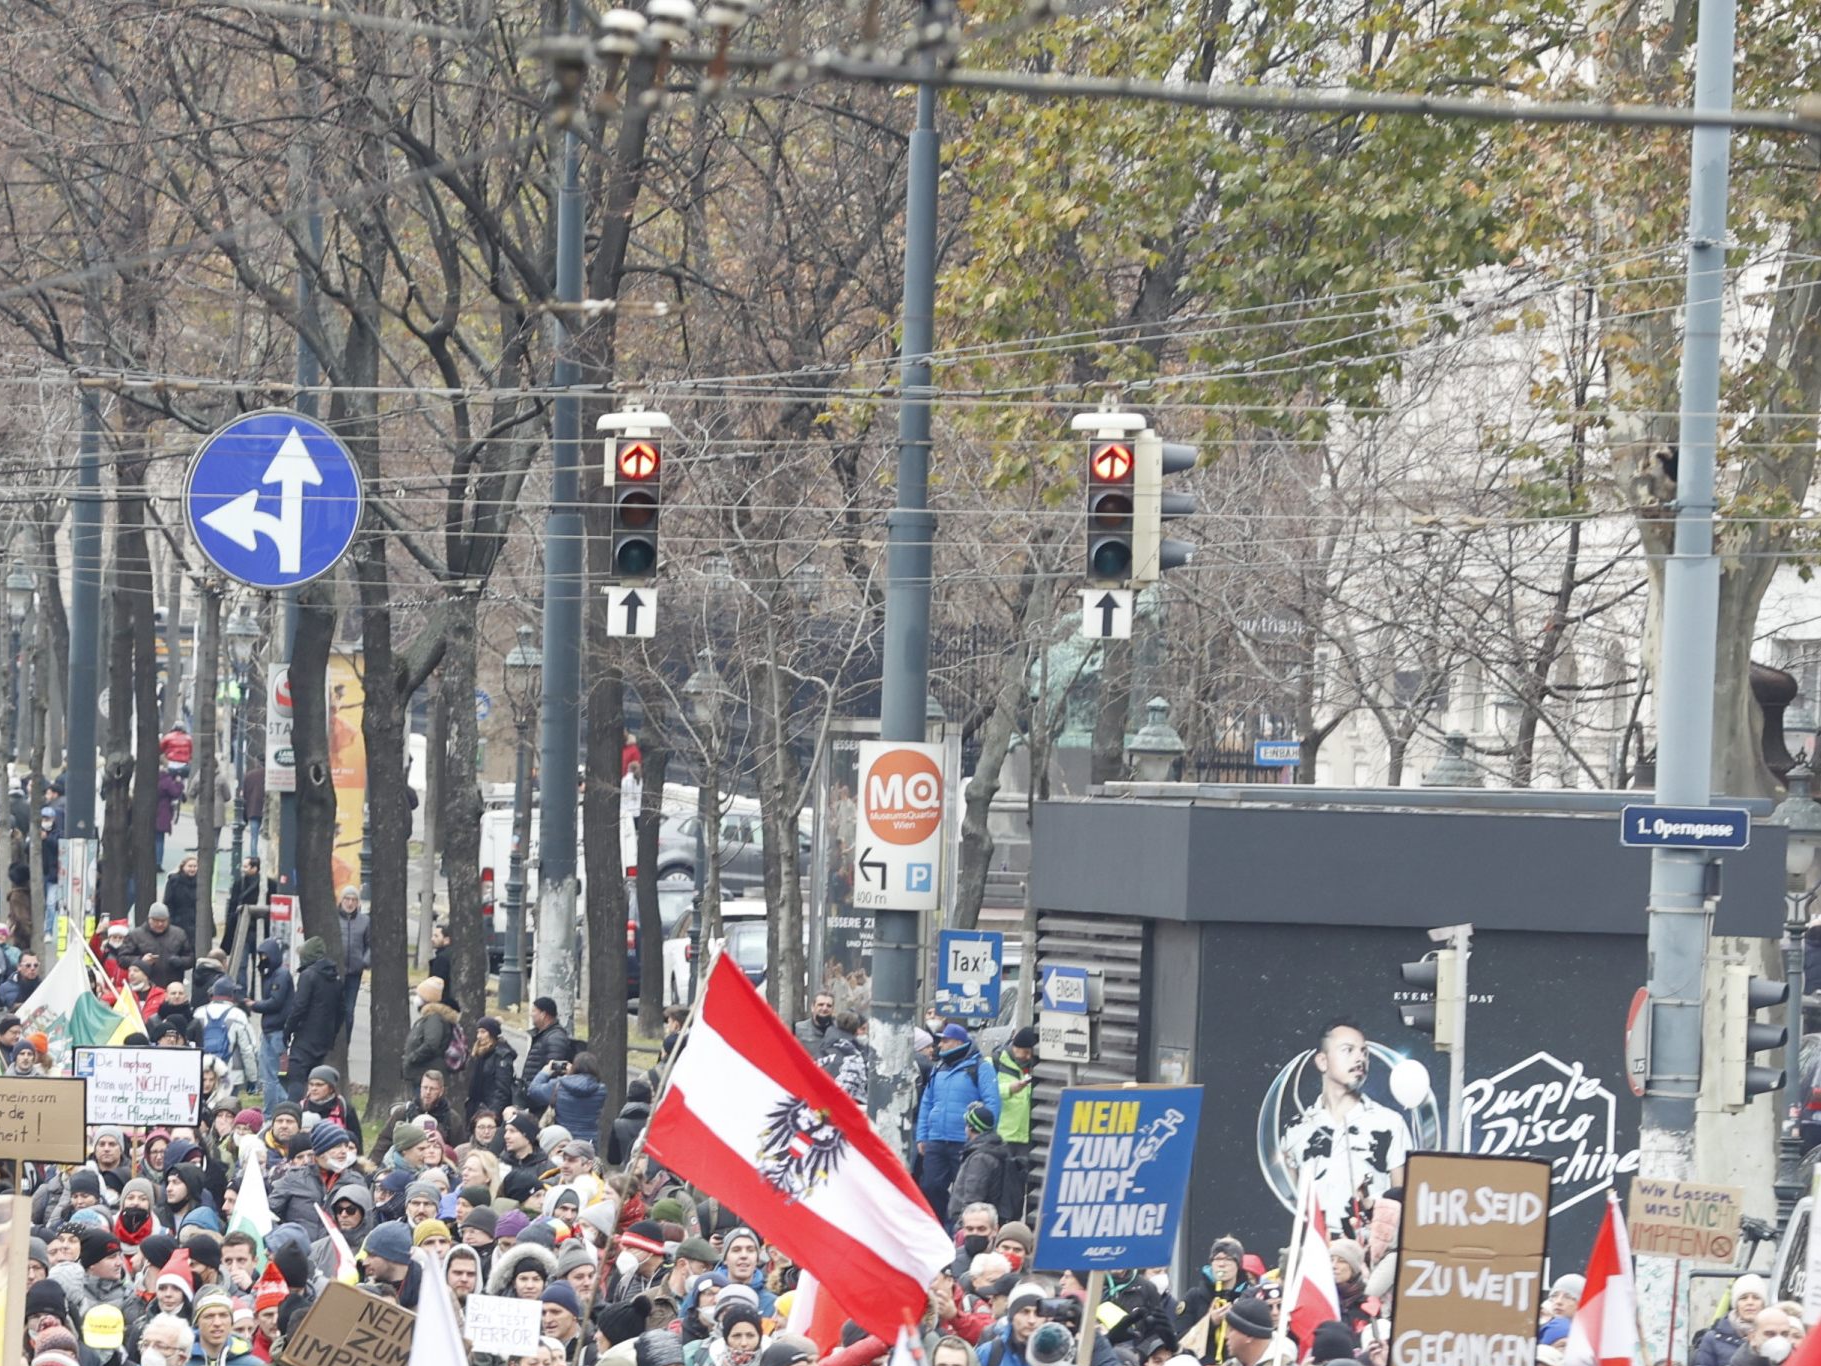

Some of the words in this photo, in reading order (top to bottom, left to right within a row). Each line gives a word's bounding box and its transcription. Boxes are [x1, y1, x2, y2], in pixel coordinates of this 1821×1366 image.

[1262, 747, 1300, 760] EINBAH
[869, 771, 940, 811] MQ
[892, 820, 916, 831] Wien
[1653, 818, 1734, 840] Operngasse
[911, 866, 929, 888] P
[952, 949, 988, 972] Taxi
[95, 1052, 113, 1069] Die
[135, 1076, 169, 1093] NICHT
[1461, 1061, 1602, 1124] Purple
[7, 1107, 25, 1120] die
[1069, 1100, 1142, 1135] NEIN
[1480, 1112, 1596, 1156] Disco
[1062, 1135, 1134, 1169] ZUM
[1551, 1138, 1640, 1186] chine
[1056, 1169, 1146, 1204] IMPF-
[1637, 1182, 1667, 1197] Wir
[1415, 1181, 1470, 1227] IHR
[1469, 1186, 1543, 1226] SEID
[1644, 1203, 1681, 1218] uns
[1682, 1201, 1739, 1229] NICHT
[1049, 1202, 1169, 1239] ZWANG!
[1630, 1222, 1710, 1259] IMPFEN
[1403, 1259, 1453, 1298] ZU
[1455, 1265, 1540, 1312] WEIT
[358, 1301, 416, 1342] NEIN
[498, 1314, 530, 1327] TEST
[470, 1326, 531, 1348] TERROR
